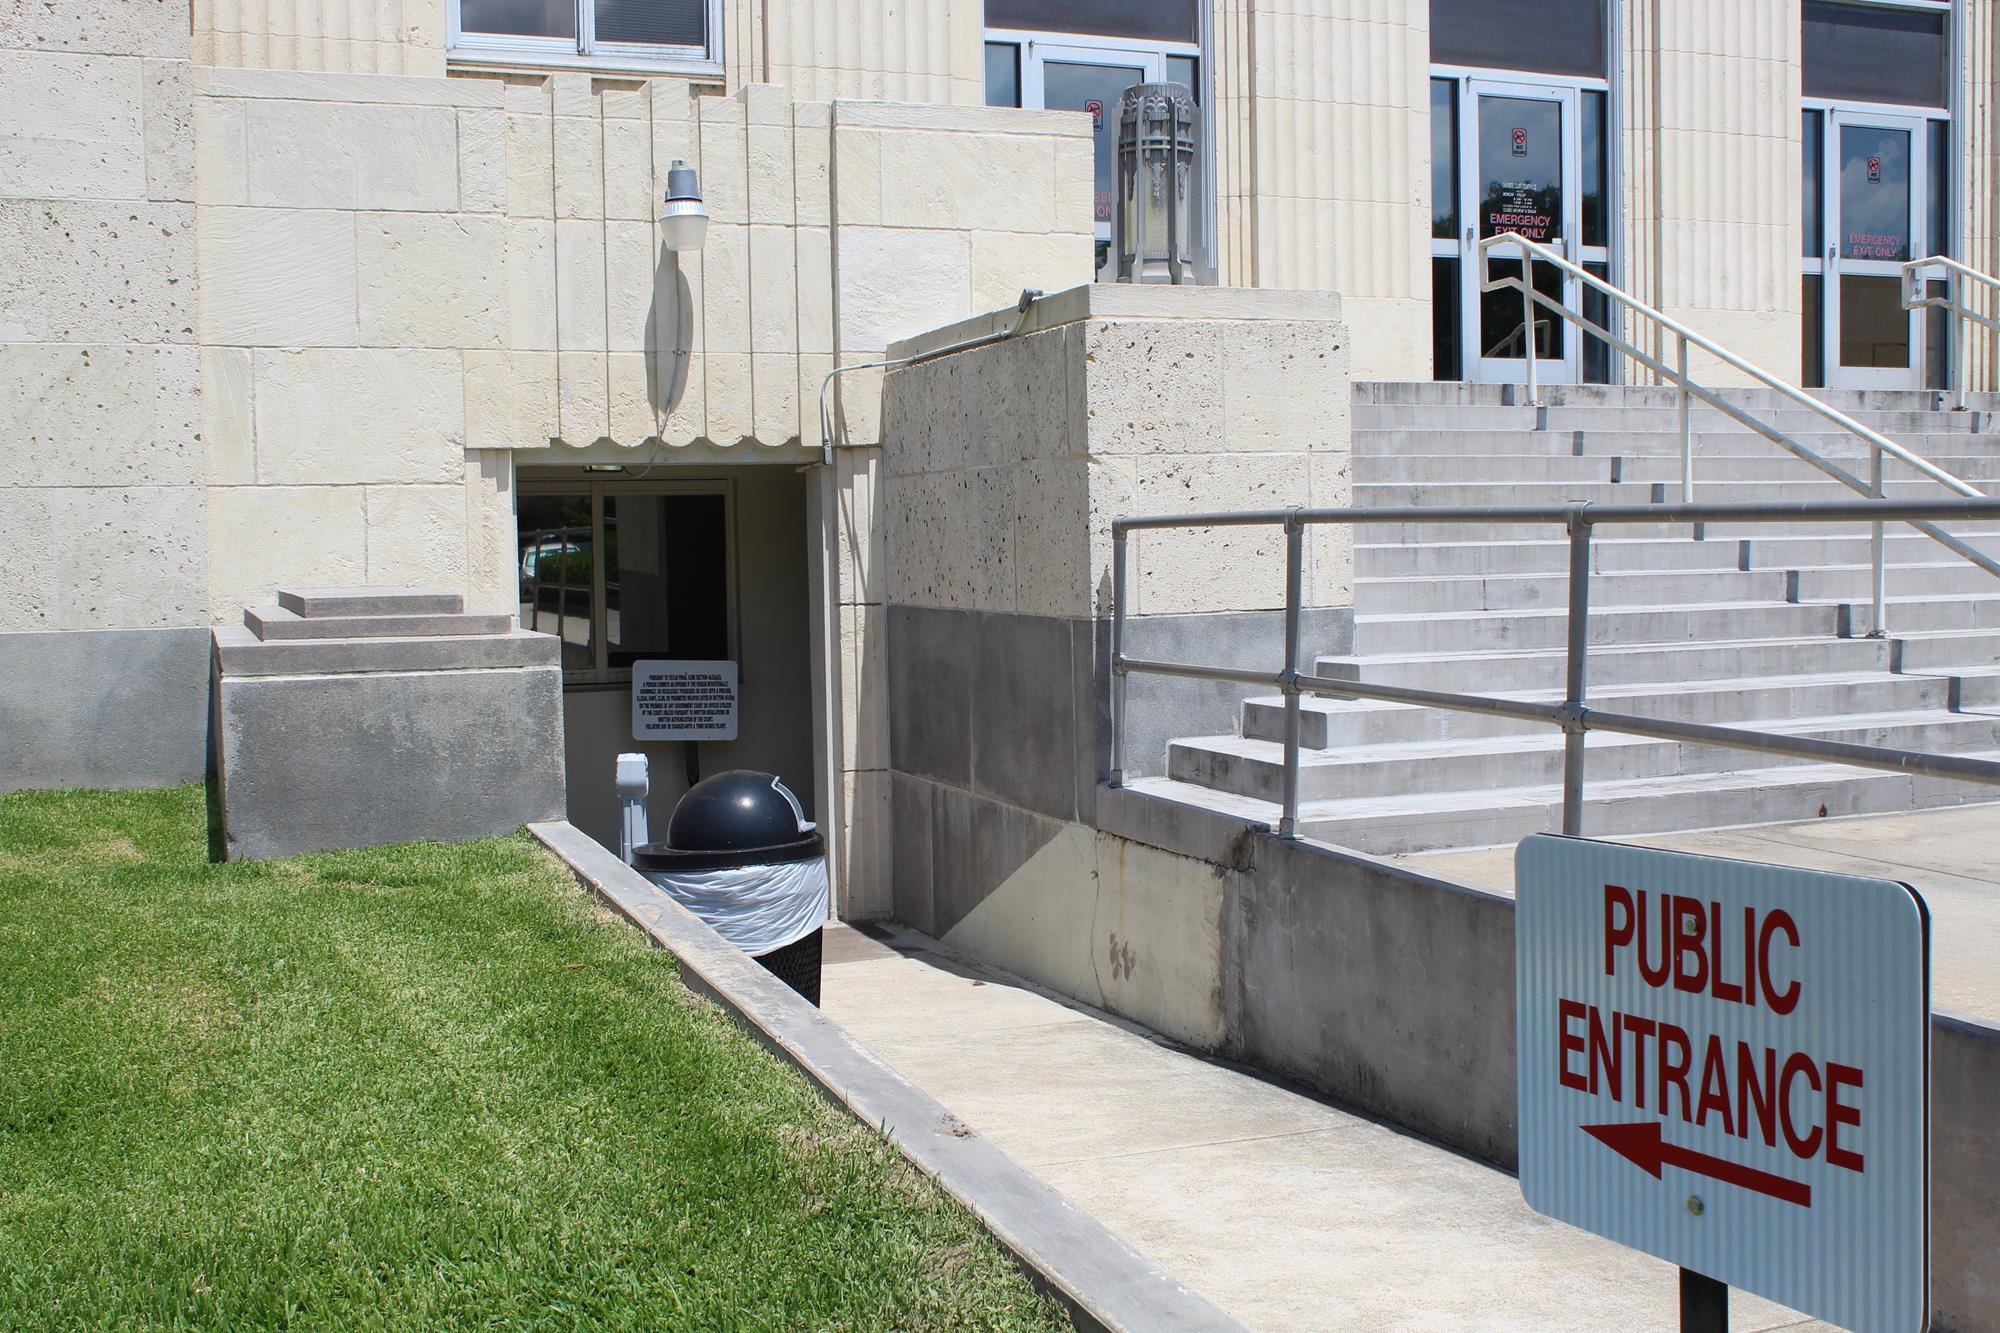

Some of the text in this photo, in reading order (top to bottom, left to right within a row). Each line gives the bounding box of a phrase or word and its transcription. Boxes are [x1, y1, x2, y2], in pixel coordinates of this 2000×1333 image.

[1490, 213, 1551, 226] EMERGENCY
[1520, 227, 1546, 239] ONLY
[1849, 233, 1901, 245] EMERGENCY
[1853, 246, 1896, 257] EXIT ONLY
[1604, 884, 1801, 1016] PUBLIC
[1558, 998, 1865, 1173] ENTRANCE
